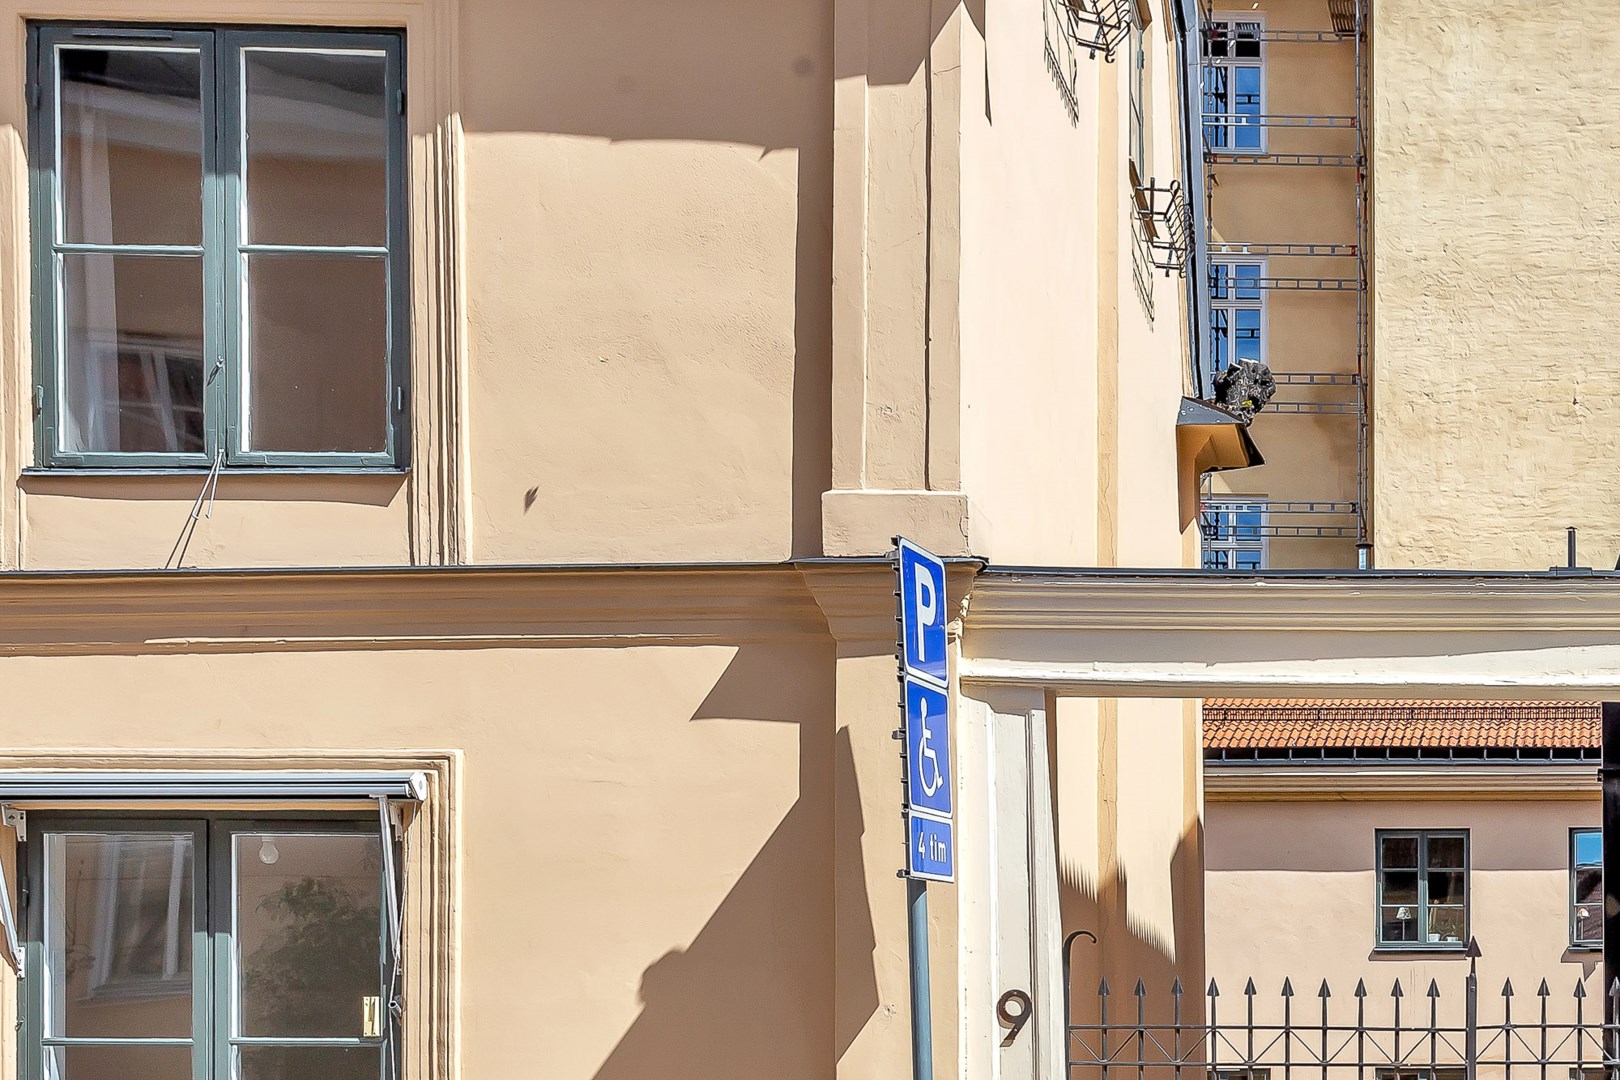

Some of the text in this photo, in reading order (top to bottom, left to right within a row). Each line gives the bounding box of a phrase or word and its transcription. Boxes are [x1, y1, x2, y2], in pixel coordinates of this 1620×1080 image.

[914, 563, 937, 663] P
[918, 831, 947, 863] 4 tim
[996, 989, 1032, 1047] 9
